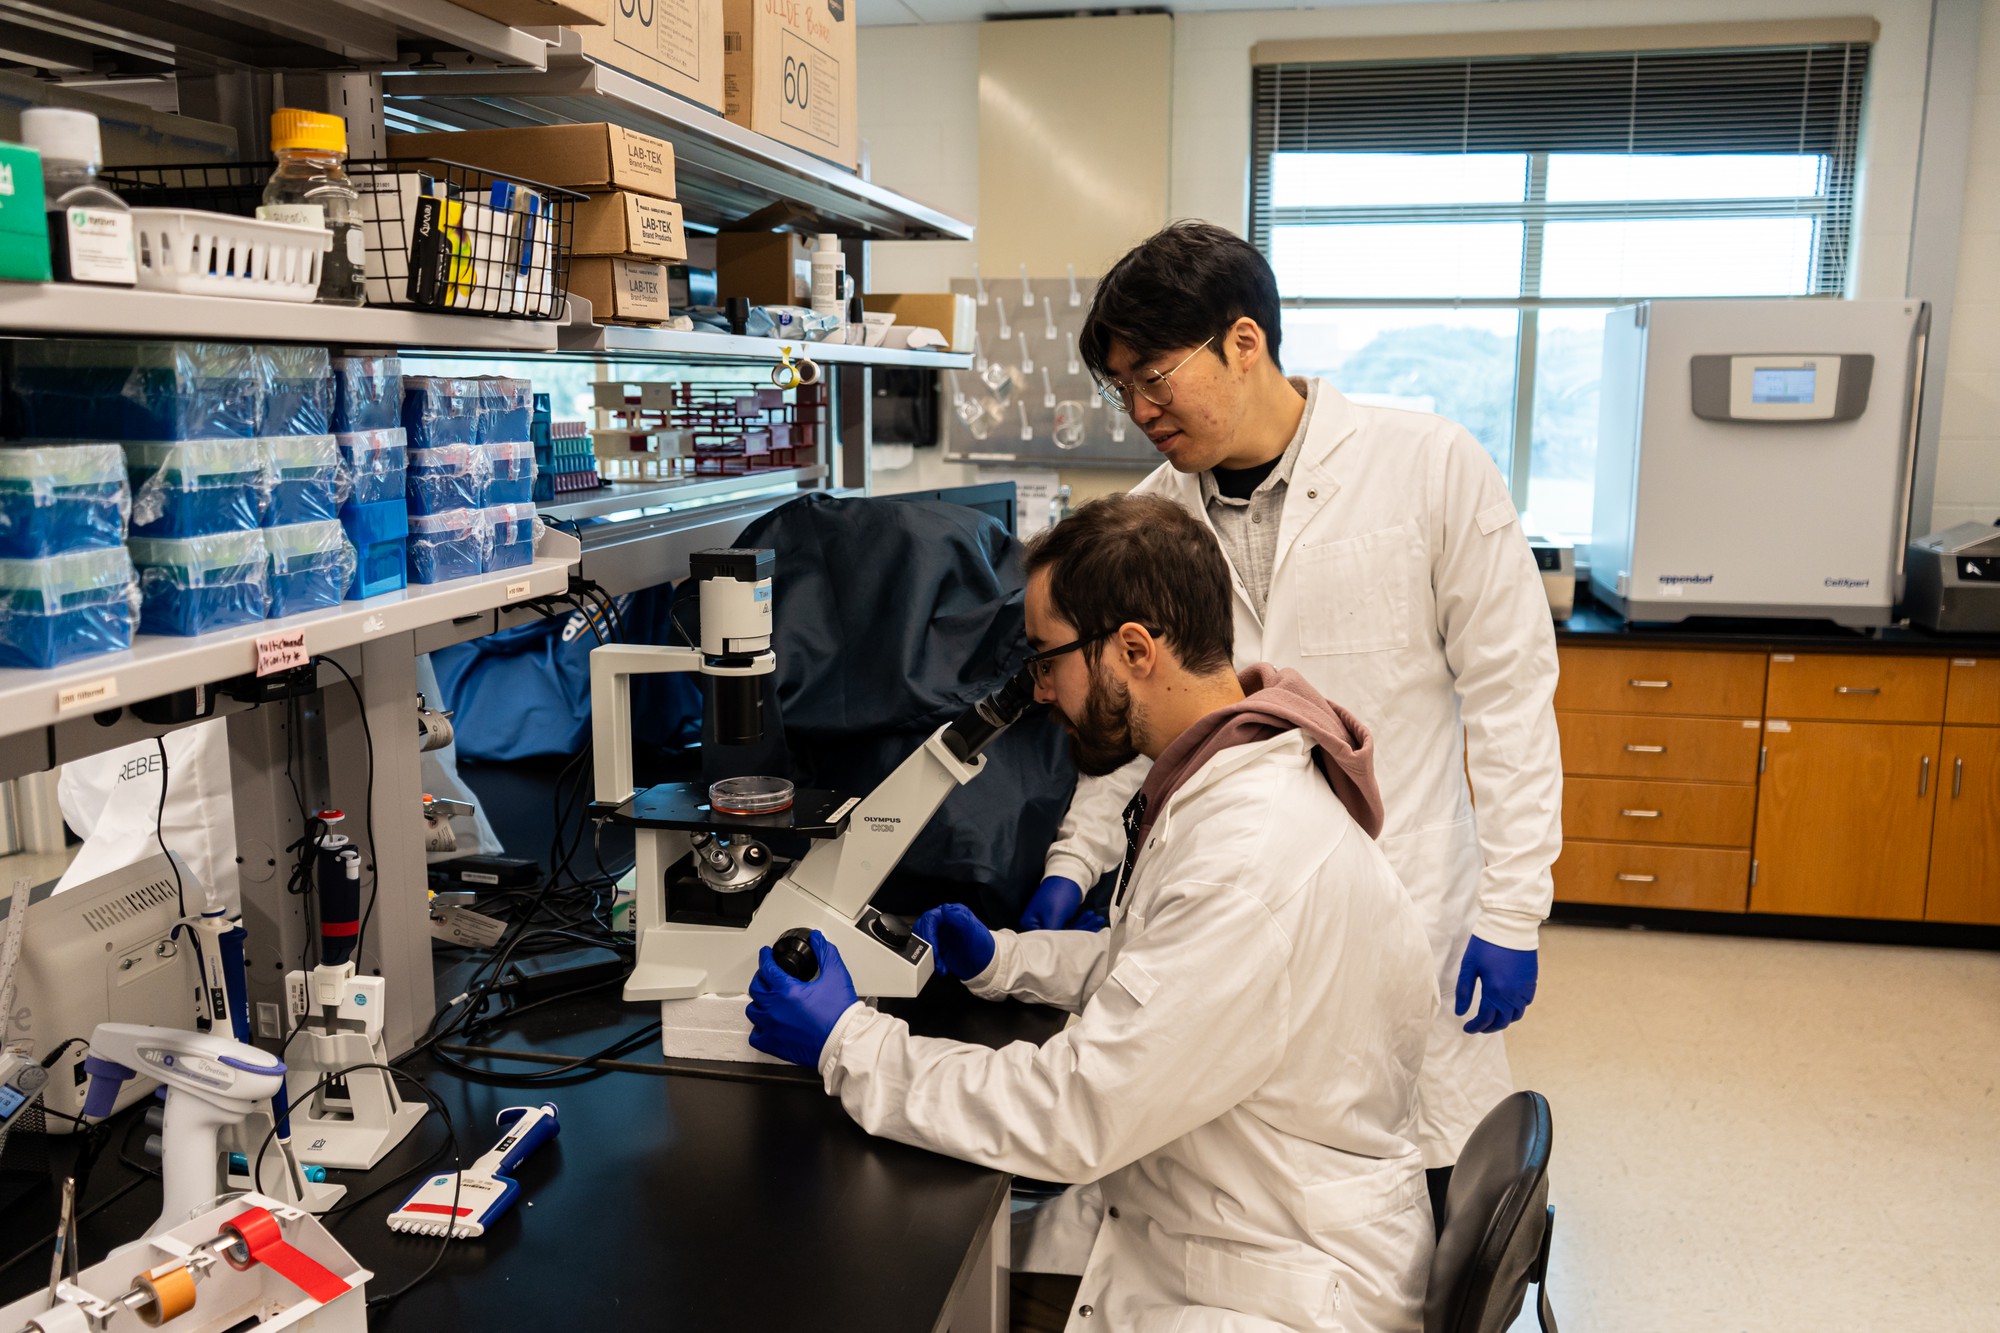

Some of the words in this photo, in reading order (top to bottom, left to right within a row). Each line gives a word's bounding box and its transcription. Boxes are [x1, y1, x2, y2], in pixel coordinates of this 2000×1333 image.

[784, 55, 809, 110] 60
[627, 144, 662, 165] LAB-TEK
[628, 158, 643, 169] Brand
[642, 162, 662, 174] Products
[420, 204, 432, 237] revvity
[641, 216, 672, 234] LAB-TEK
[642, 230, 655, 240] Brand
[654, 232, 672, 243] Products
[628, 279, 659, 295] LAB-TEK
[630, 293, 642, 302] Brand
[641, 295, 658, 303] Products
[1659, 574, 1714, 585] eppendorf
[118, 753, 170, 784] REBE
[864, 816, 901, 824] OLYMPUS
